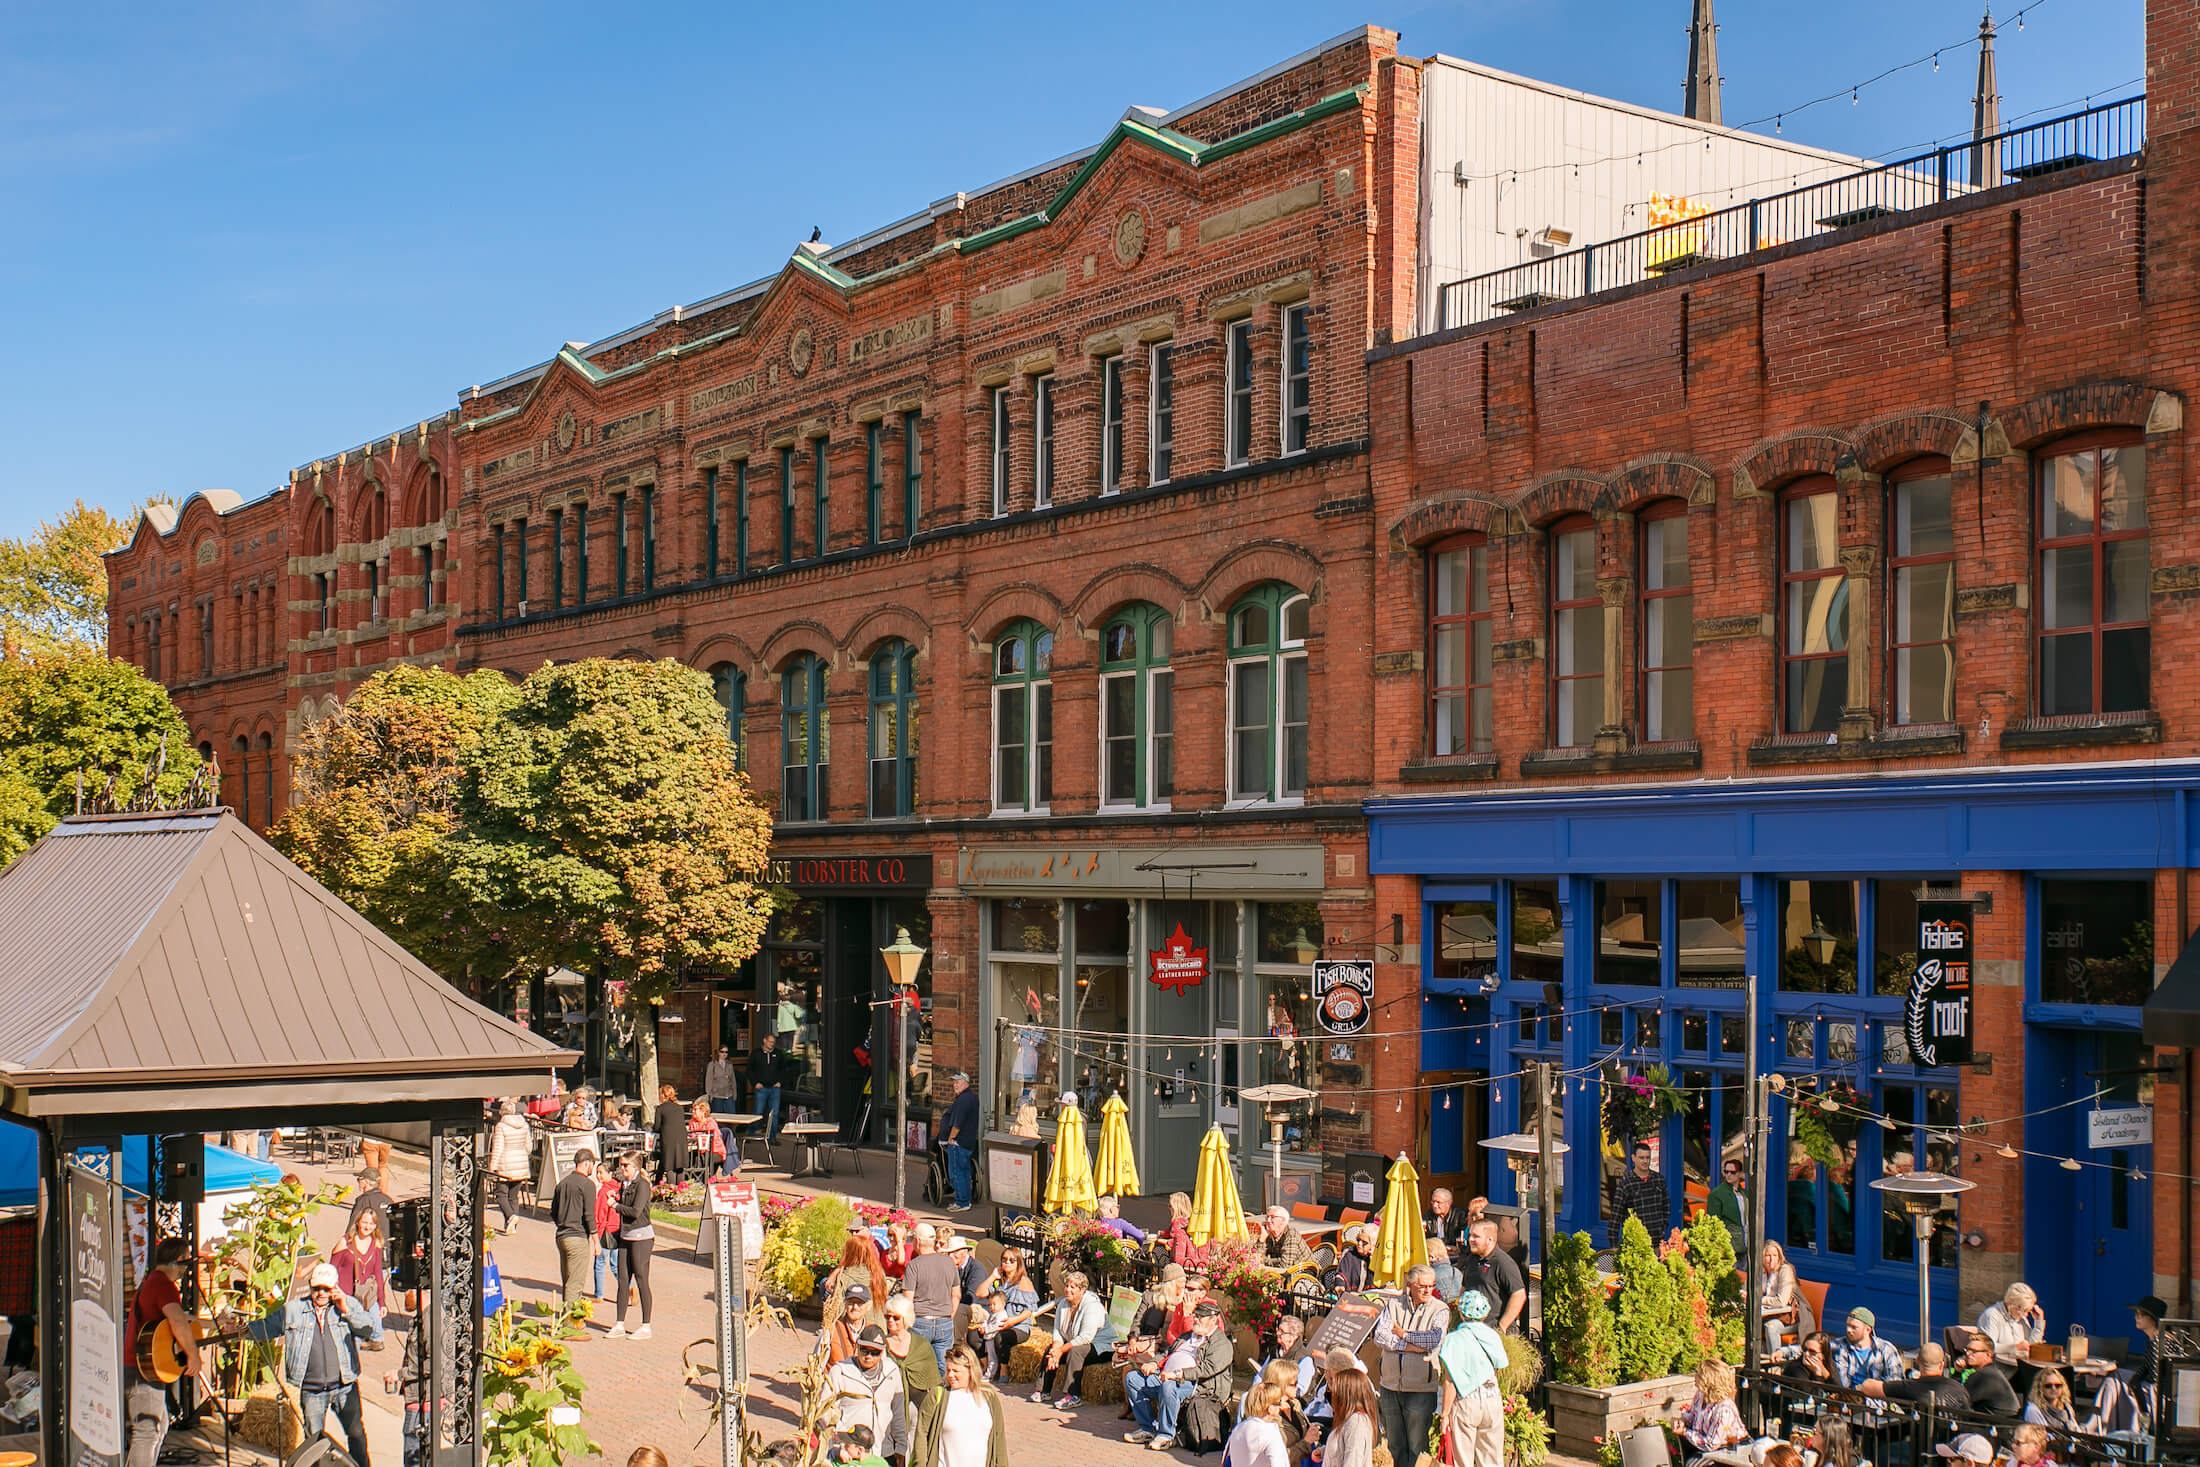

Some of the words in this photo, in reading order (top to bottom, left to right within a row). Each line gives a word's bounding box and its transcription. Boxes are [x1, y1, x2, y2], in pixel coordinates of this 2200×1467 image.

[863, 319, 917, 355] BLOCK
[799, 858, 871, 883] LOBSTER
[877, 858, 907, 883] CO.
[1158, 971, 1181, 979] LEATHER
[1932, 996, 1968, 1038] roof
